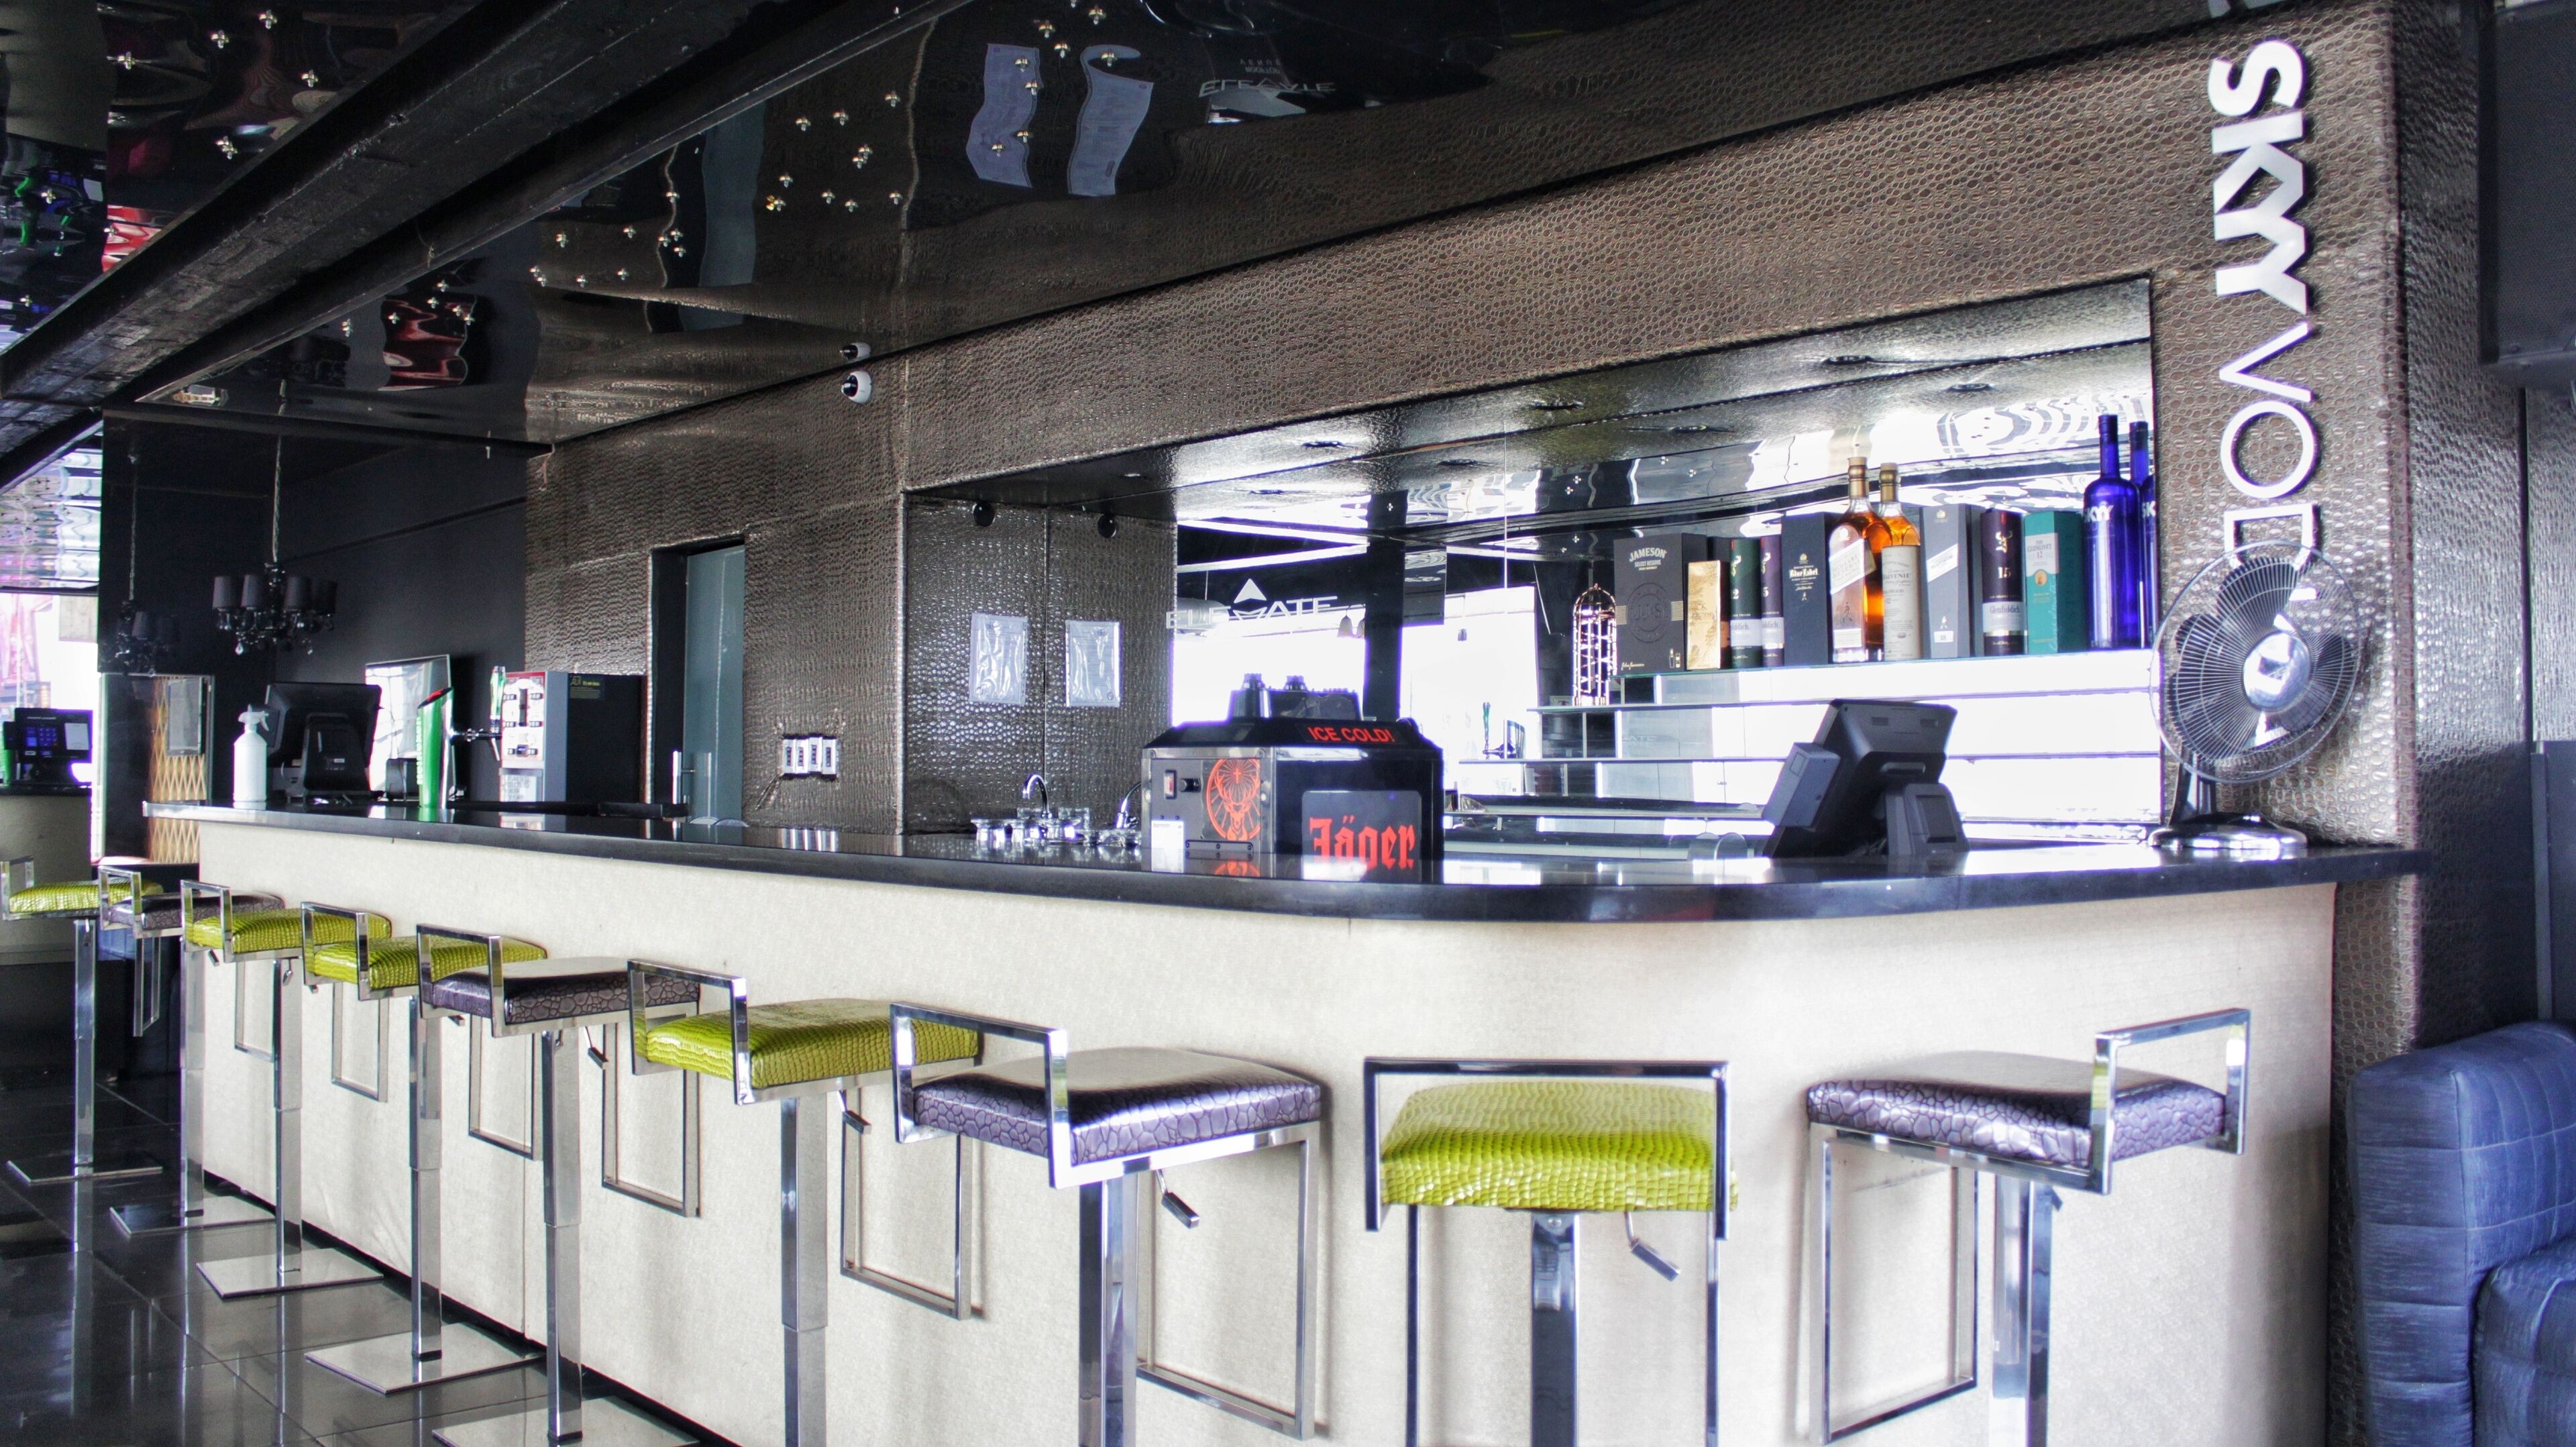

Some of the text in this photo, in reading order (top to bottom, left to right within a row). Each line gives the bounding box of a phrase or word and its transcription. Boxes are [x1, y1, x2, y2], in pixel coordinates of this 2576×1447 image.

[2208, 39, 2309, 316] SKYY
[1629, 547, 1667, 562] JAMESON
[1997, 566, 2011, 579] 15
[1307, 727, 1395, 742] ICE COLD!
